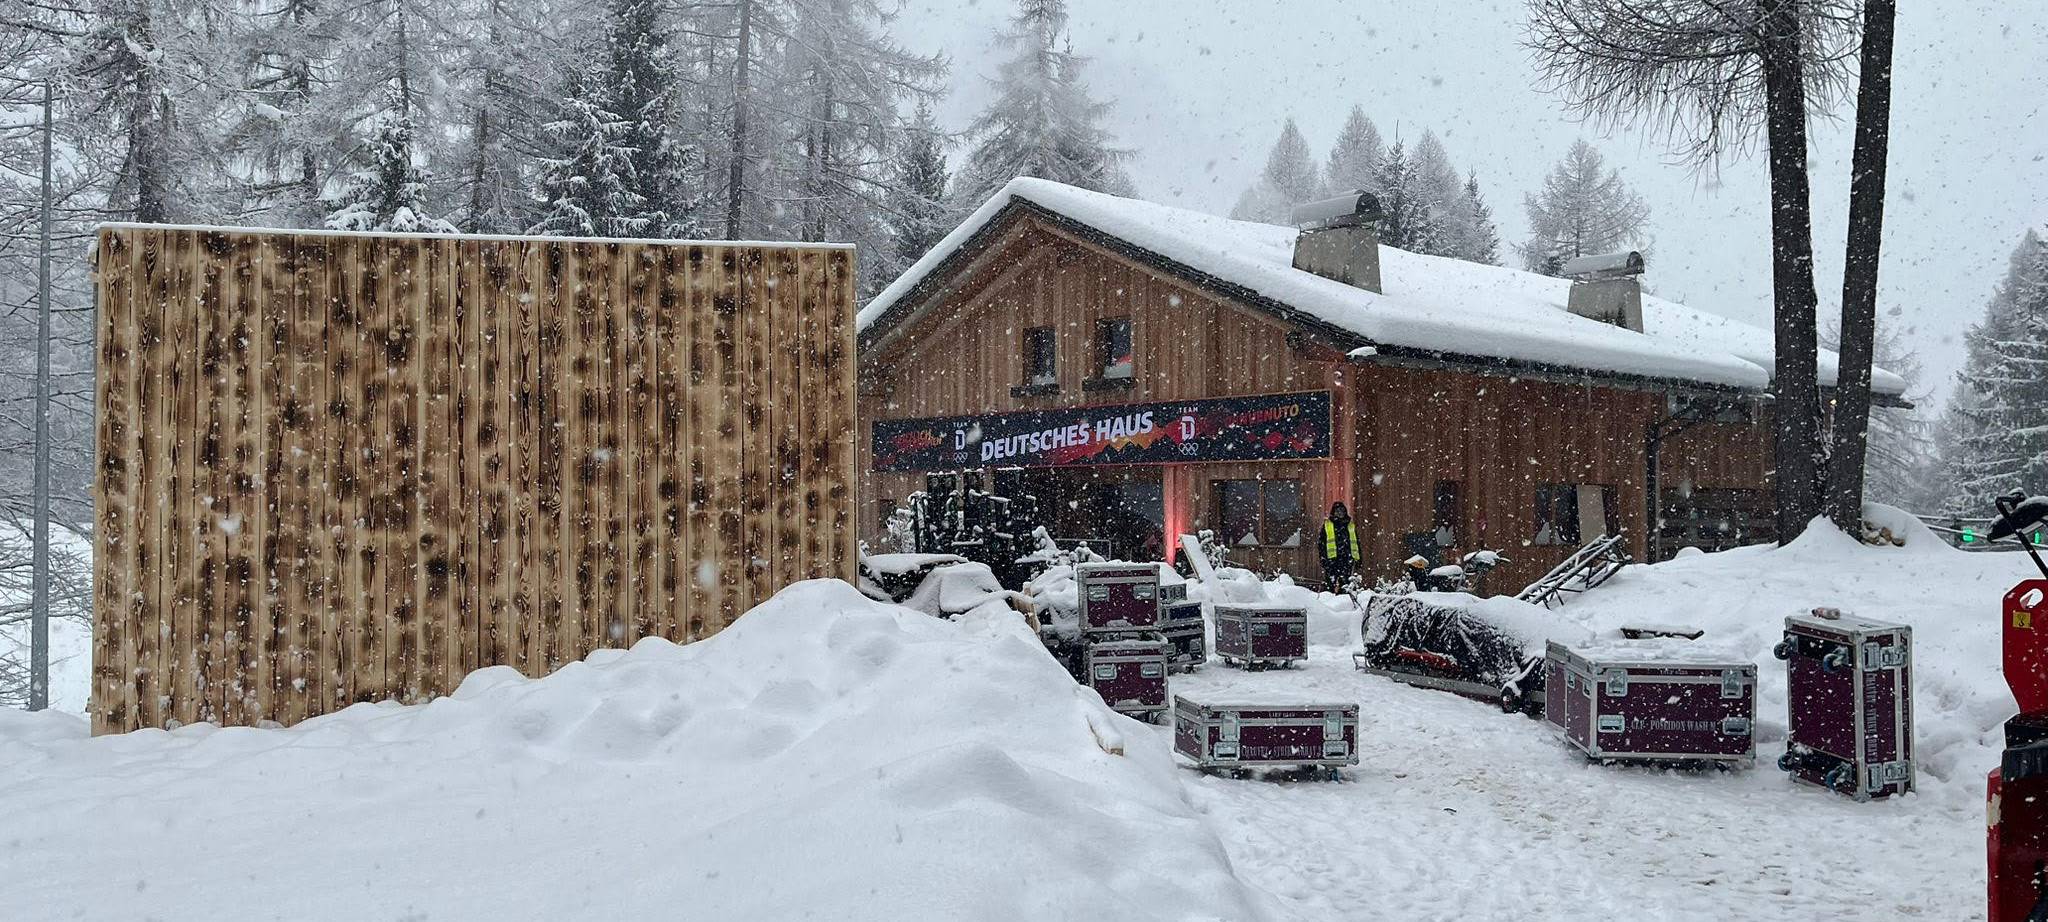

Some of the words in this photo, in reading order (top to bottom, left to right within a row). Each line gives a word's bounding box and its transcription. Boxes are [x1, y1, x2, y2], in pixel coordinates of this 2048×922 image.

[1179, 406, 1199, 414] TEAM
[981, 422, 1090, 462] DEUTSCHES
[1095, 411, 1154, 442] HAUS
[1650, 720, 1687, 731] POSEIDON
[1687, 720, 1708, 731] WASH
